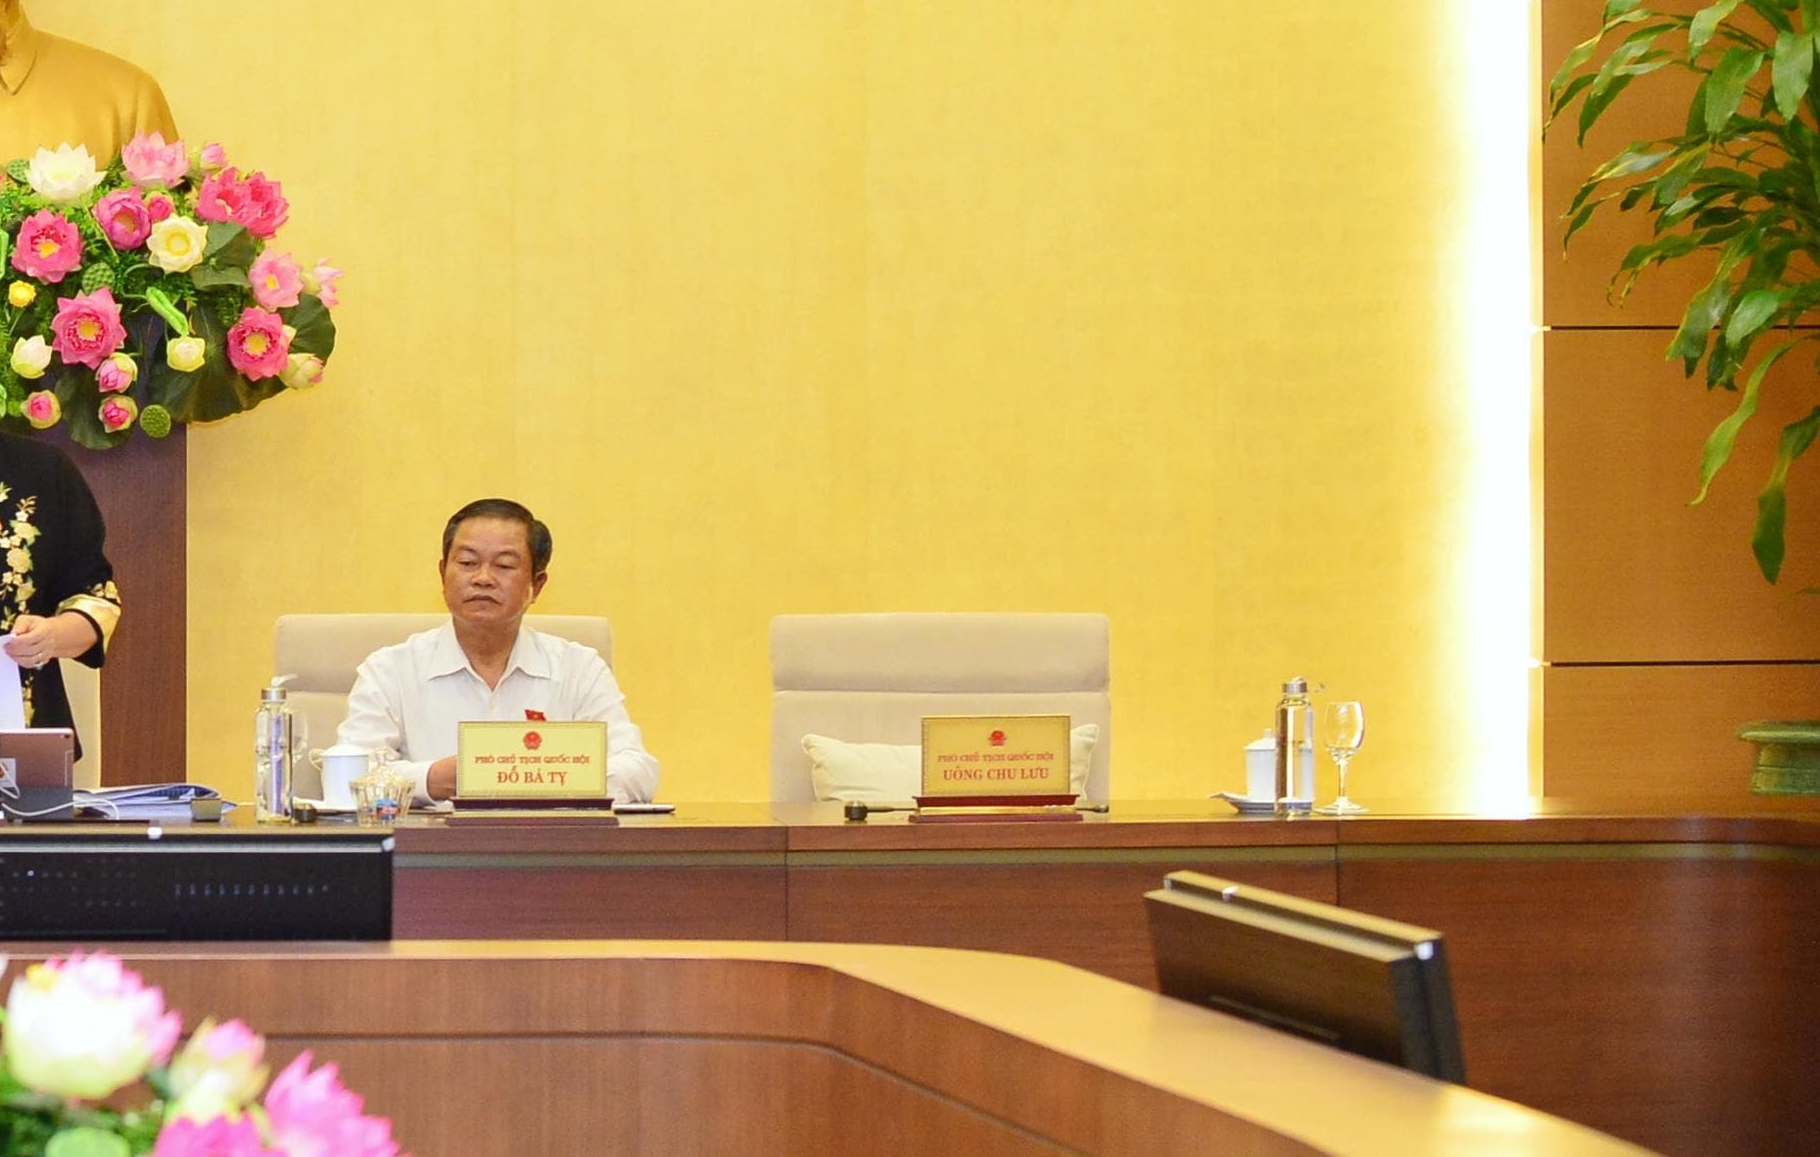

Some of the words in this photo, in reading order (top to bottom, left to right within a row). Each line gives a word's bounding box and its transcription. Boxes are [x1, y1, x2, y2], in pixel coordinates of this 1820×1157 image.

[524, 768, 544, 783] BÁ
[547, 771, 567, 787] TỴ
[987, 768, 1016, 779] CHU
[1020, 767, 1049, 779] LƯU
